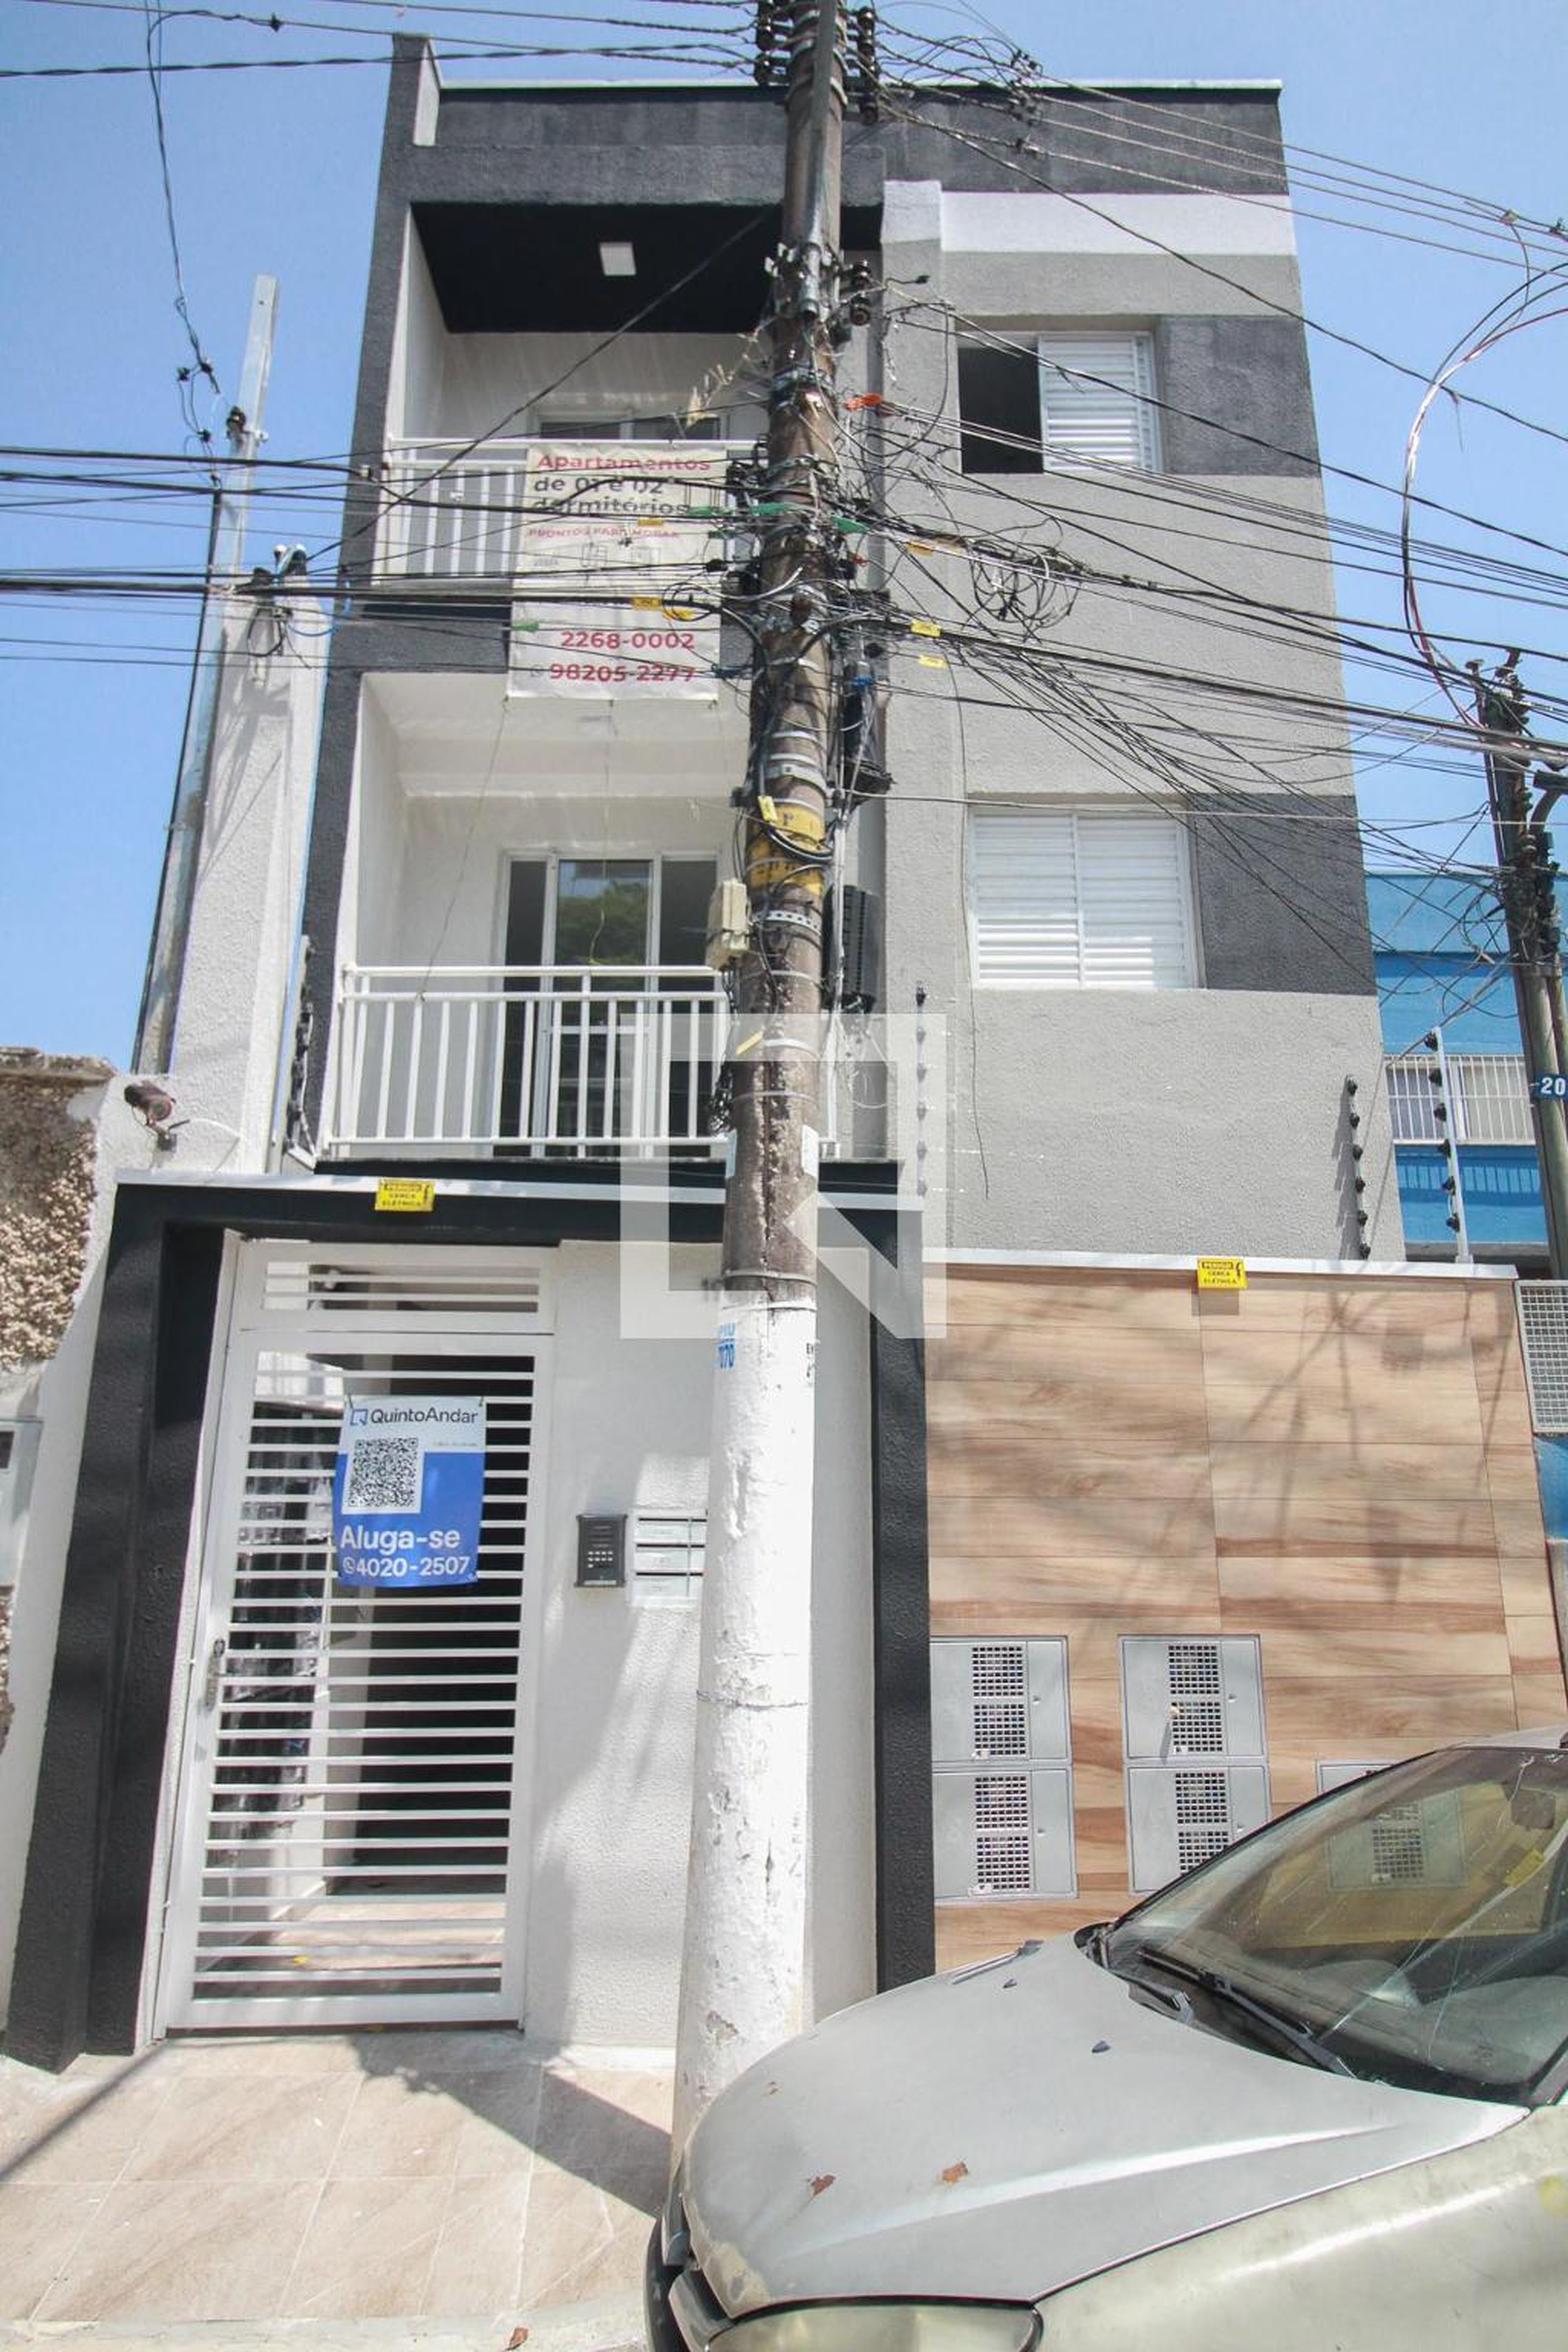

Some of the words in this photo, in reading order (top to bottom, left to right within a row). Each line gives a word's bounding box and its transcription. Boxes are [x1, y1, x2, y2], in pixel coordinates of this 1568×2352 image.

[538, 454, 711, 471] Apartamentos
[534, 477, 566, 492] de
[562, 631, 695, 649] 2268-0002
[550, 663, 695, 682] 98205-2277
[1541, 1076, 1566, 1096] 20
[371, 1407, 478, 1424] QuintoAndar
[340, 1525, 461, 1555] Aluga-se
